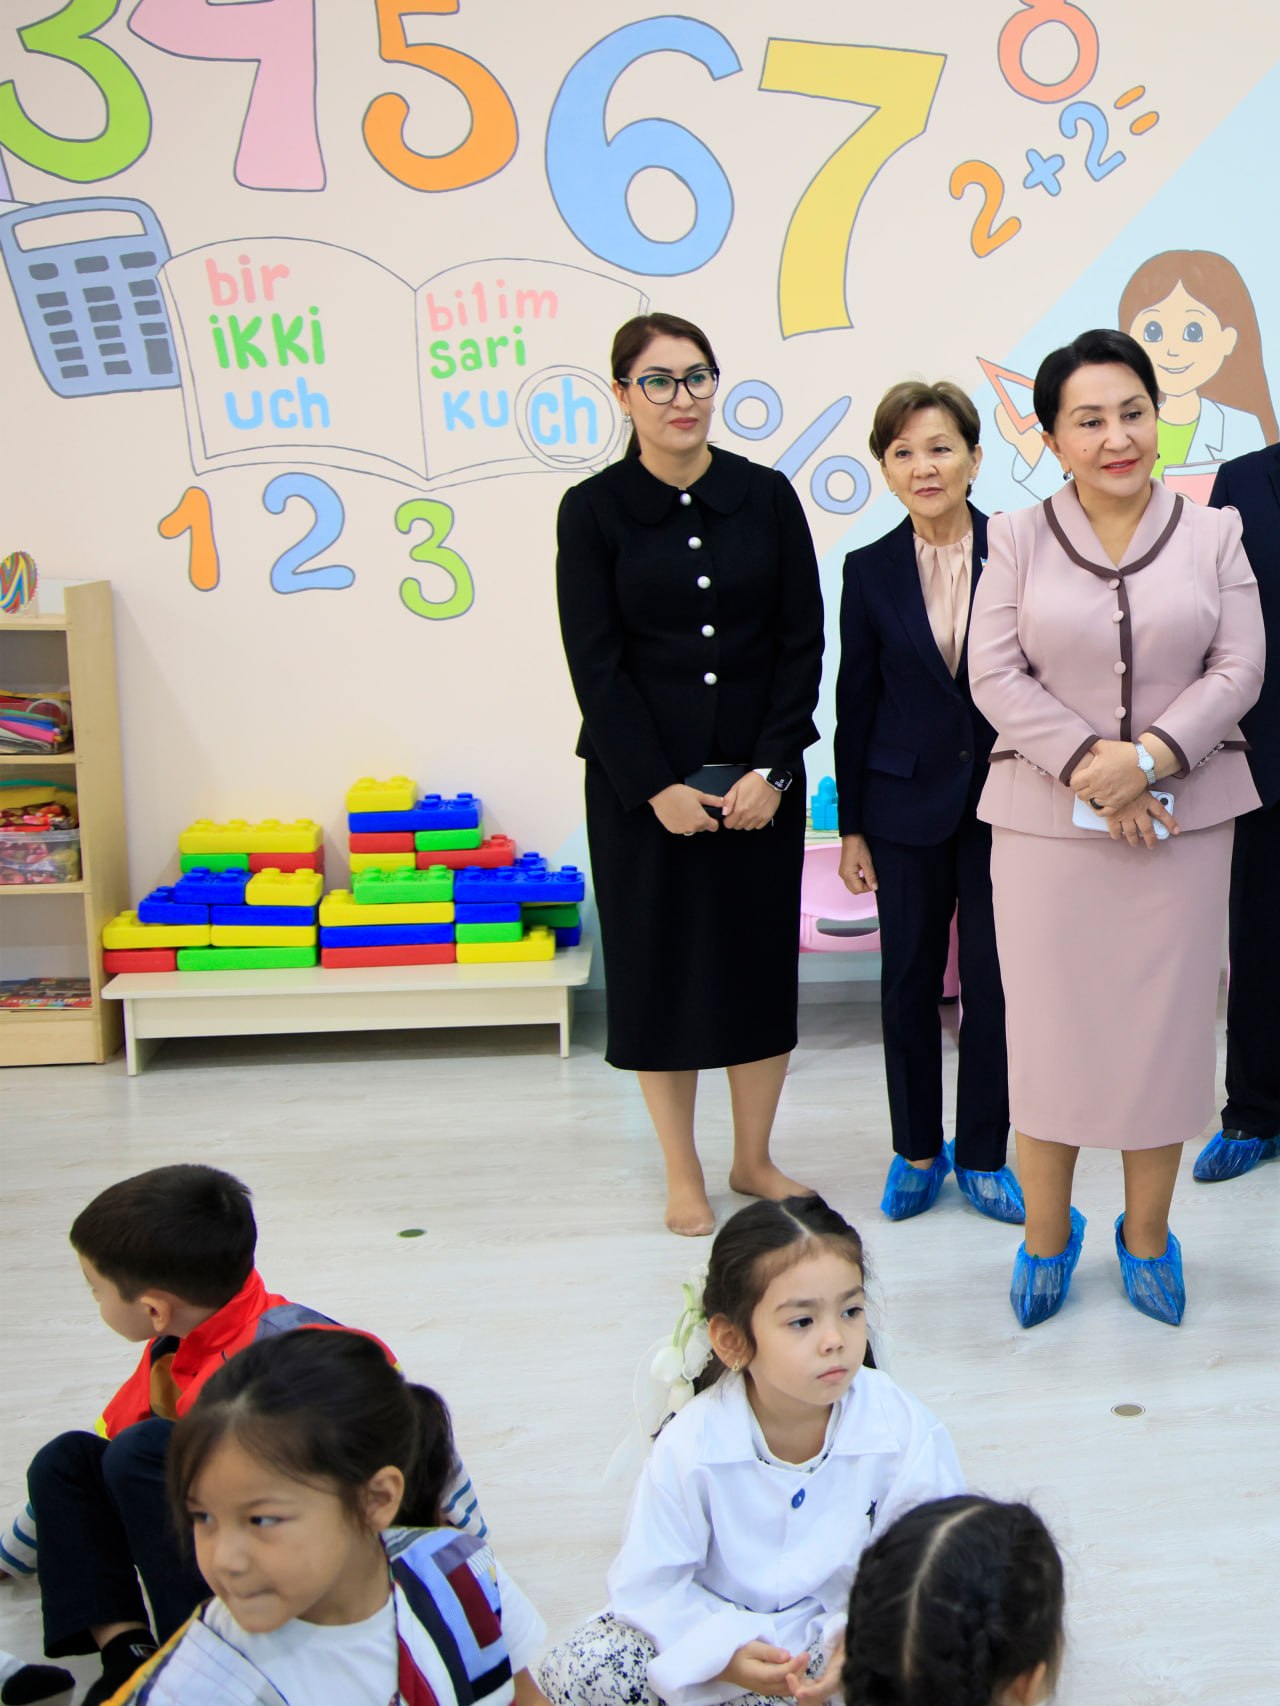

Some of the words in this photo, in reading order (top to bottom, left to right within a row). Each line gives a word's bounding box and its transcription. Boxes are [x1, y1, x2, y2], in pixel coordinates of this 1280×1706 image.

[362, 0, 519, 194] 5
[544, 15, 743, 278] 6
[758, 37, 948, 341] 7
[205, 254, 290, 307] bir
[429, 325, 527, 380] sari
[224, 376, 331, 430] uch
[157, 486, 221, 592] 1
[262, 472, 356, 595] 2
[394, 498, 475, 621] 3
